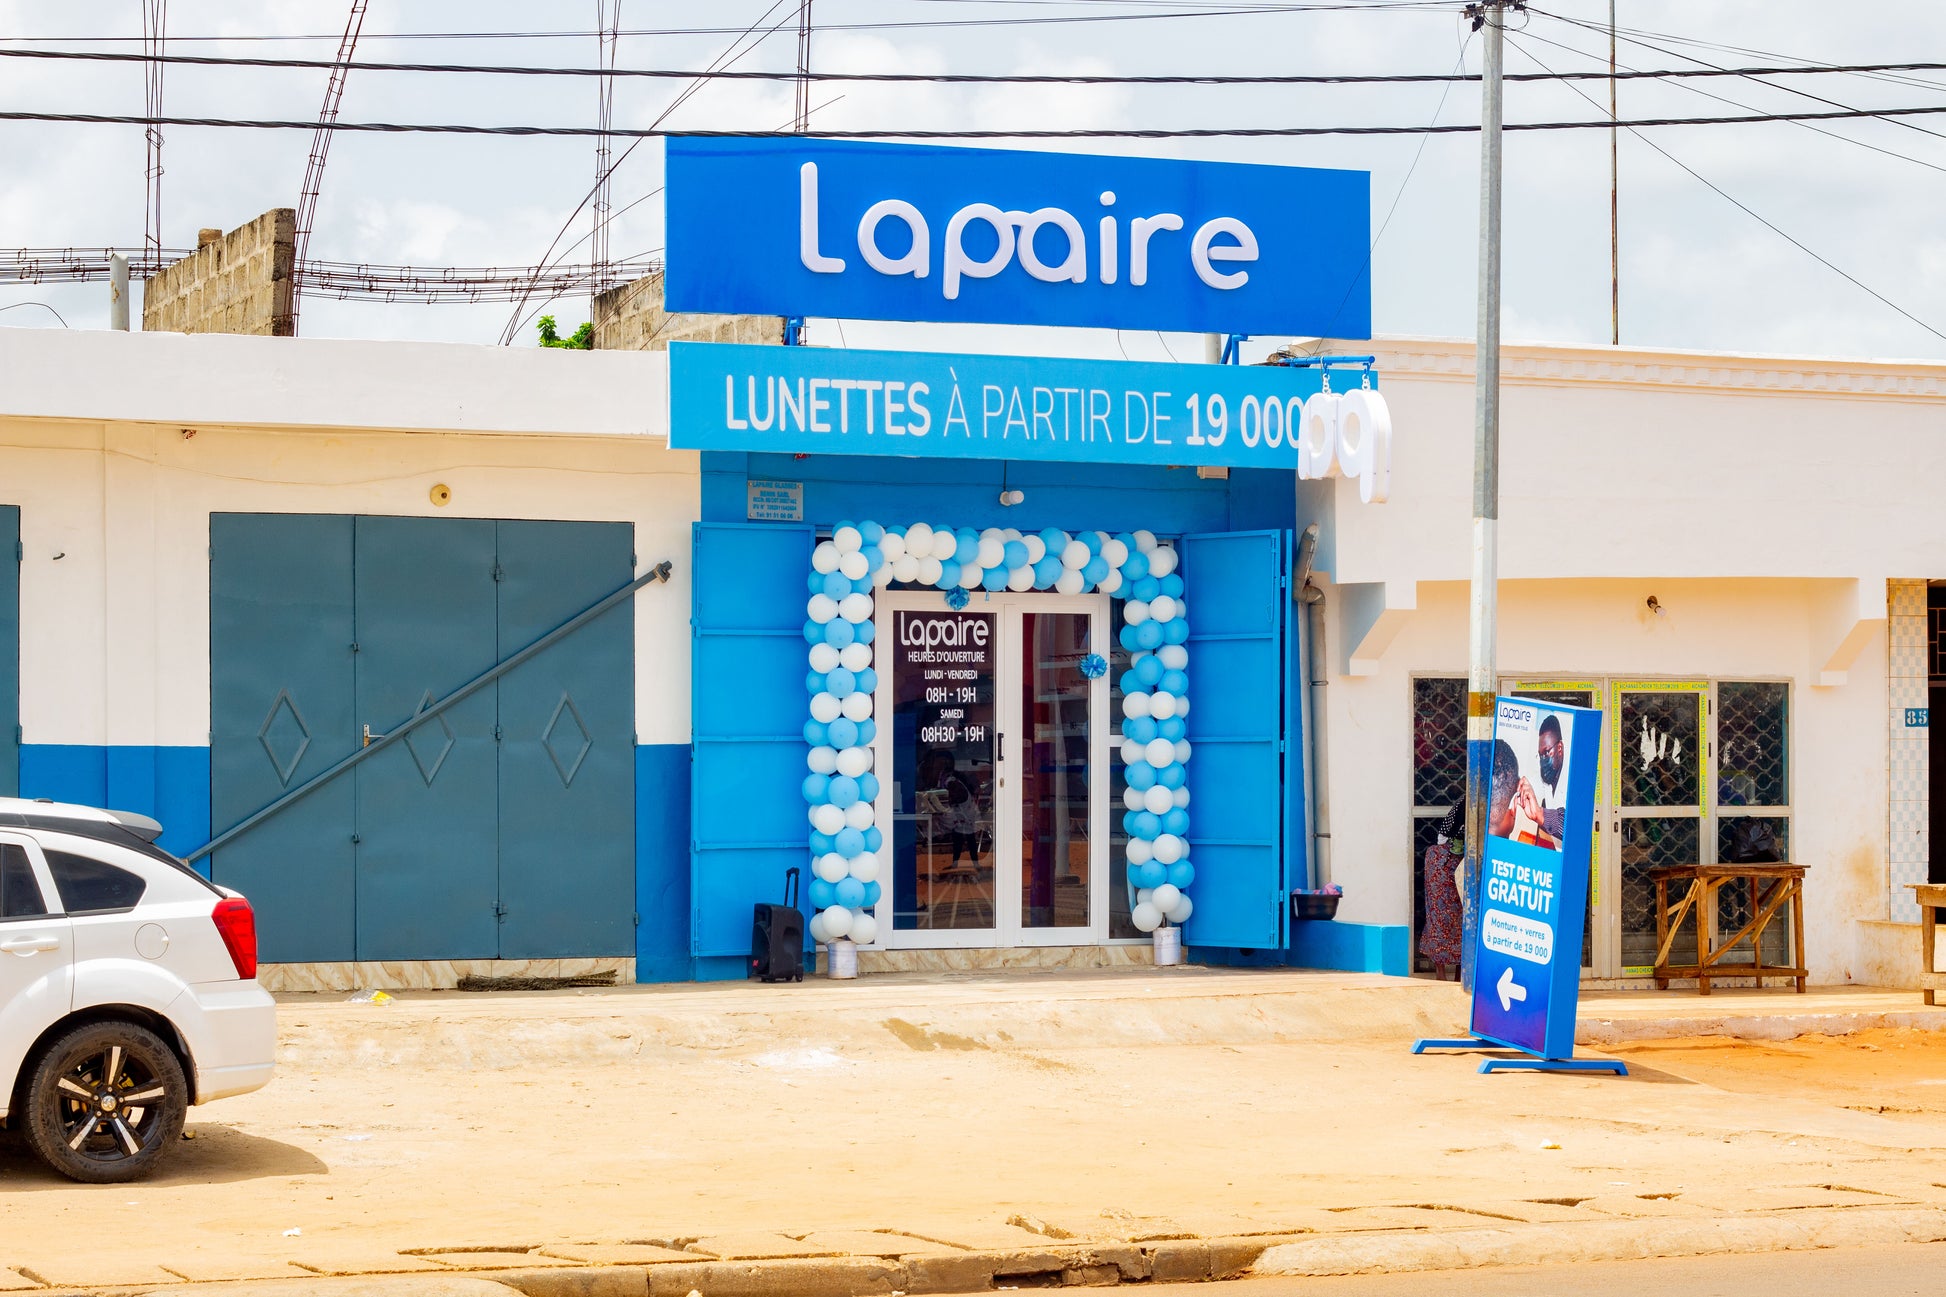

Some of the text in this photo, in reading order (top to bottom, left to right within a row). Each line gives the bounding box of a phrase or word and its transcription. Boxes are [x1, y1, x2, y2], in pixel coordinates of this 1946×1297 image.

[799, 161, 1260, 300] Lapaire
[725, 374, 931, 437] LUNETTES
[943, 367, 971, 439] À
[983, 385, 1112, 445] PARTIR
[1125, 389, 1172, 446] DE
[1184, 392, 1229, 448] 19
[900, 611, 989, 652] Lapaire
[908, 651, 985, 662] HEURES D'OUVERTURE
[924, 670, 944, 680] LUNDI
[947, 670, 978, 680] VENDREDI
[926, 687, 947, 703] 08H
[956, 687, 976, 703] 19H
[940, 708, 964, 719] SAMEDI
[1499, 703, 1532, 722] Lapaire
[1906, 710, 1928, 725] 85
[921, 726, 955, 743] 08H30
[964, 726, 985, 742] 19H
[1491, 858, 1553, 889] TEST DE VUE
[1487, 877, 1554, 915] GRATUIT
[1491, 917, 1518, 933] Monture
[1525, 928, 1545, 940] verres
[1487, 932, 1548, 958] à partir de 19 000
